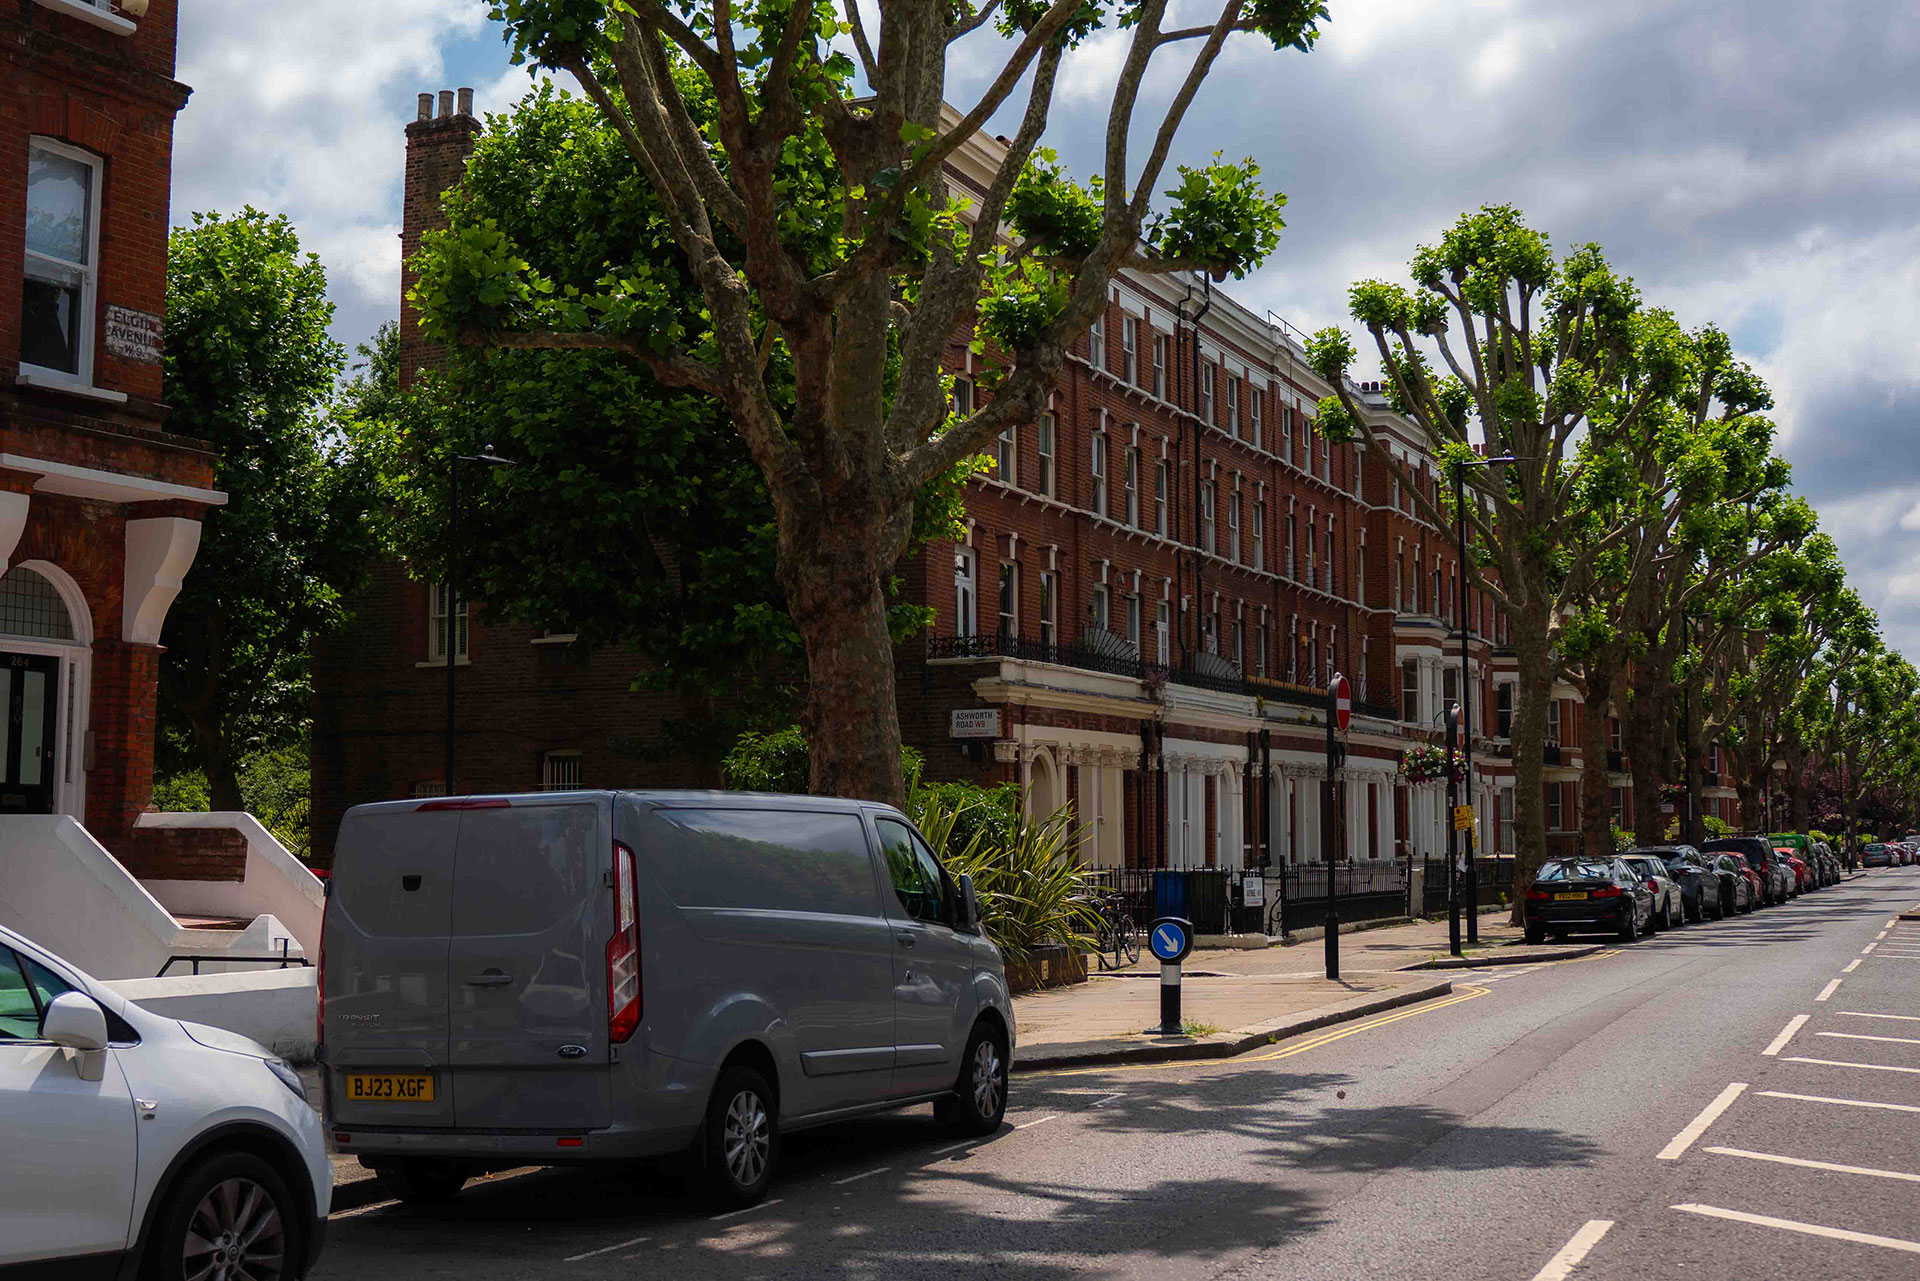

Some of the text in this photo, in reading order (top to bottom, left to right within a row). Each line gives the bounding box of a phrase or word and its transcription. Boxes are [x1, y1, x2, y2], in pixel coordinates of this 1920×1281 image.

[111, 325, 158, 347] AVENU
[956, 711, 993, 720] ASHWORTH
[956, 720, 974, 729] ROAD
[354, 1077, 426, 1097] BJ23 XGF
